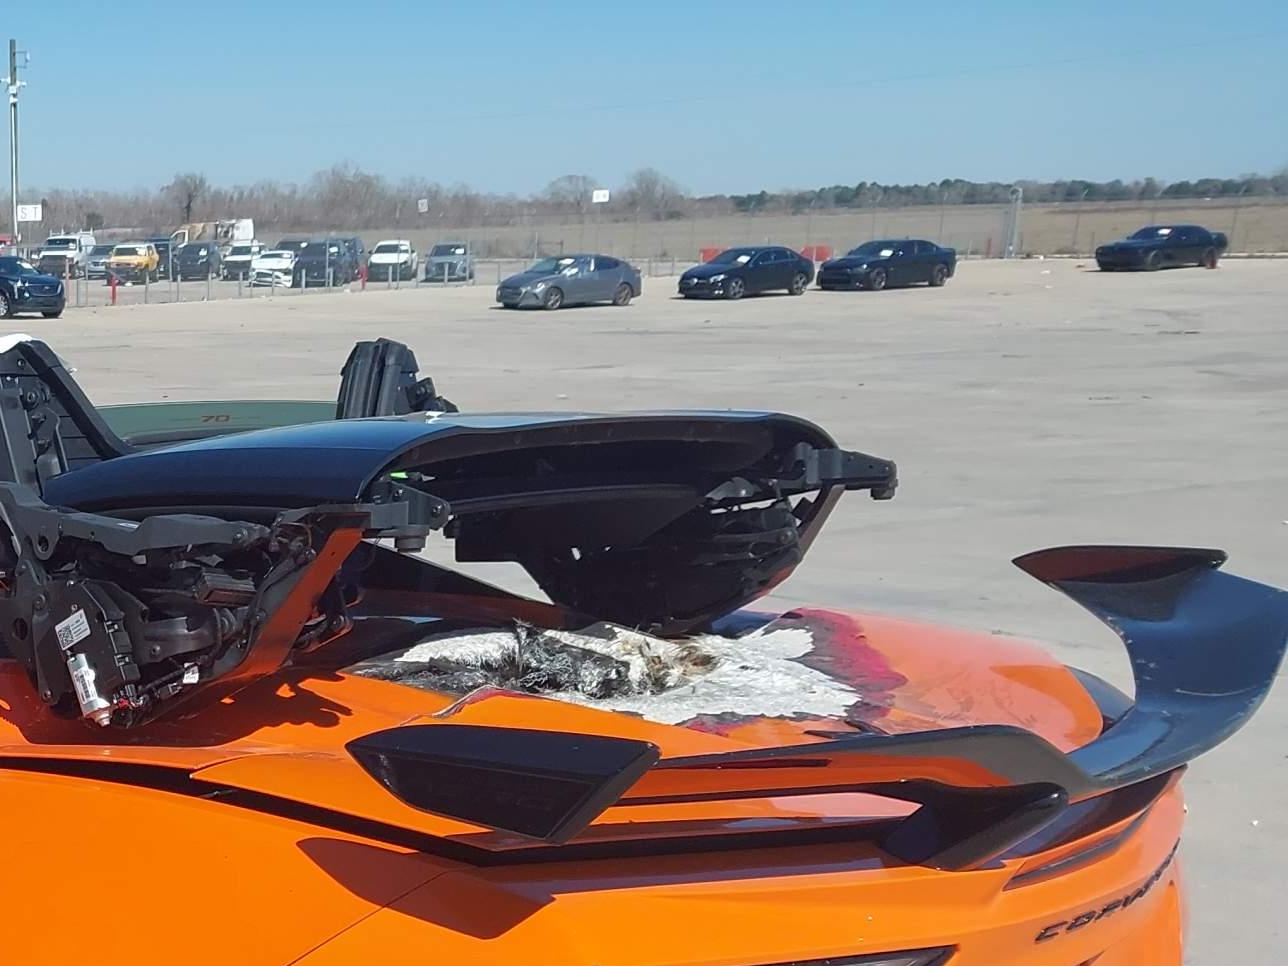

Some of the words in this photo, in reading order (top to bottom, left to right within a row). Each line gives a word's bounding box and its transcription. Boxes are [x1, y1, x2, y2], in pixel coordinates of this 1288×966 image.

[20, 206, 28, 220] S
[31, 206, 39, 220] T
[1034, 836, 1181, 945] CORV
